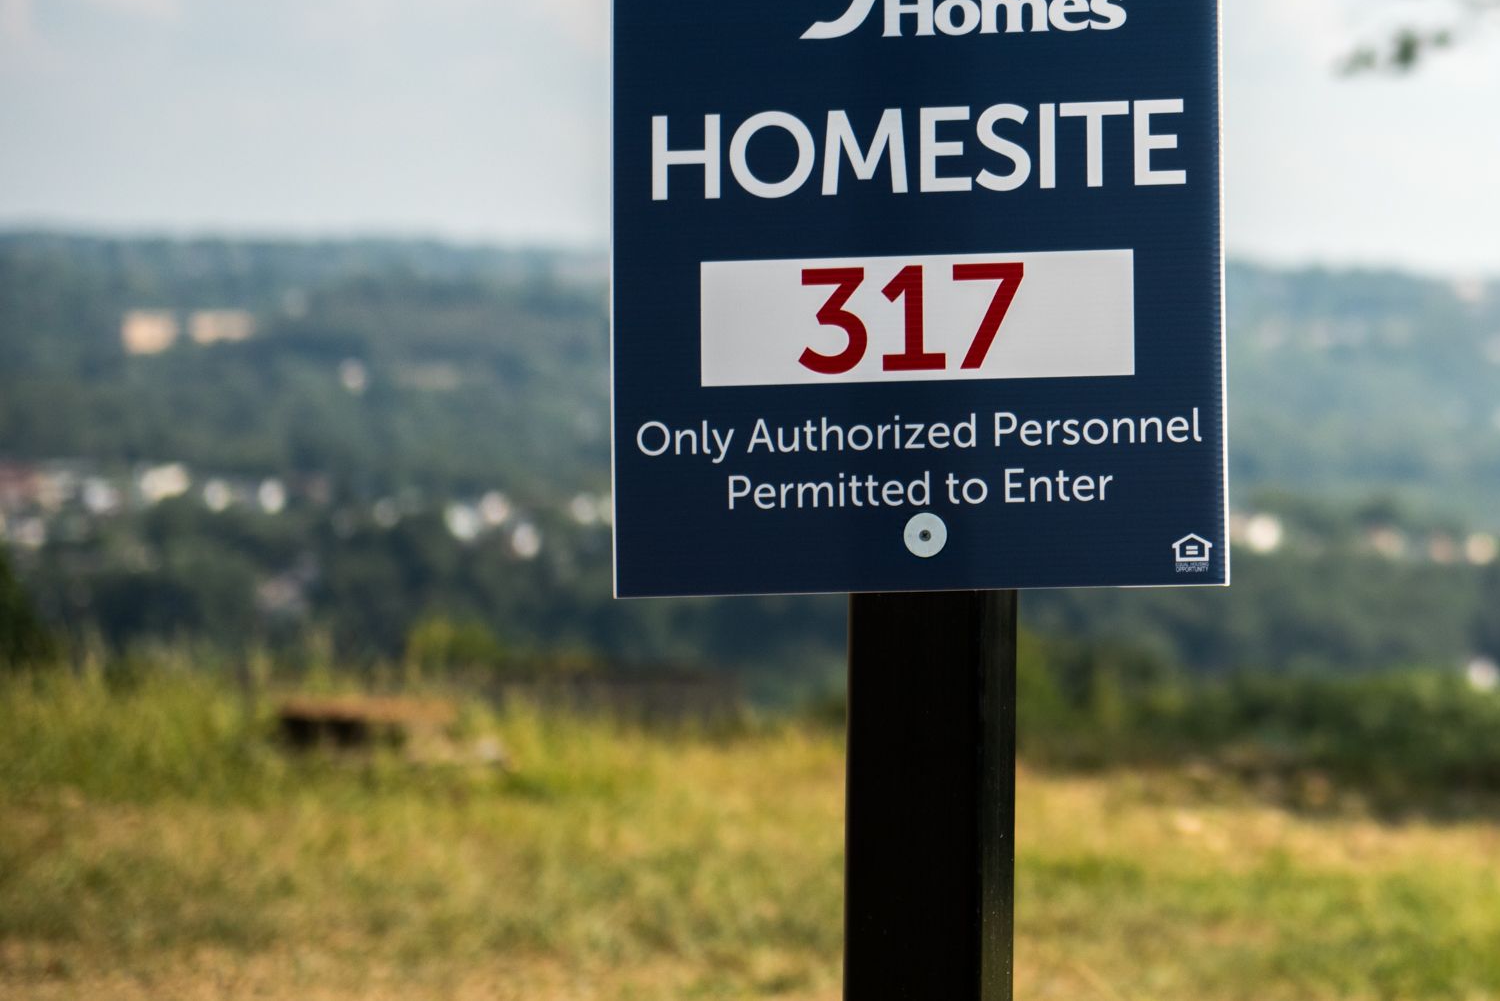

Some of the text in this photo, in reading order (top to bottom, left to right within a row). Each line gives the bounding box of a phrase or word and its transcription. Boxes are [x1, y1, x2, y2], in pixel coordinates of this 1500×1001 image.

[651, 98, 1187, 201] HOMESITE
[798, 261, 1024, 375] 317
[636, 407, 1202, 463] Only Authorized Personnel
[727, 467, 1114, 510] Permitted to Enter
